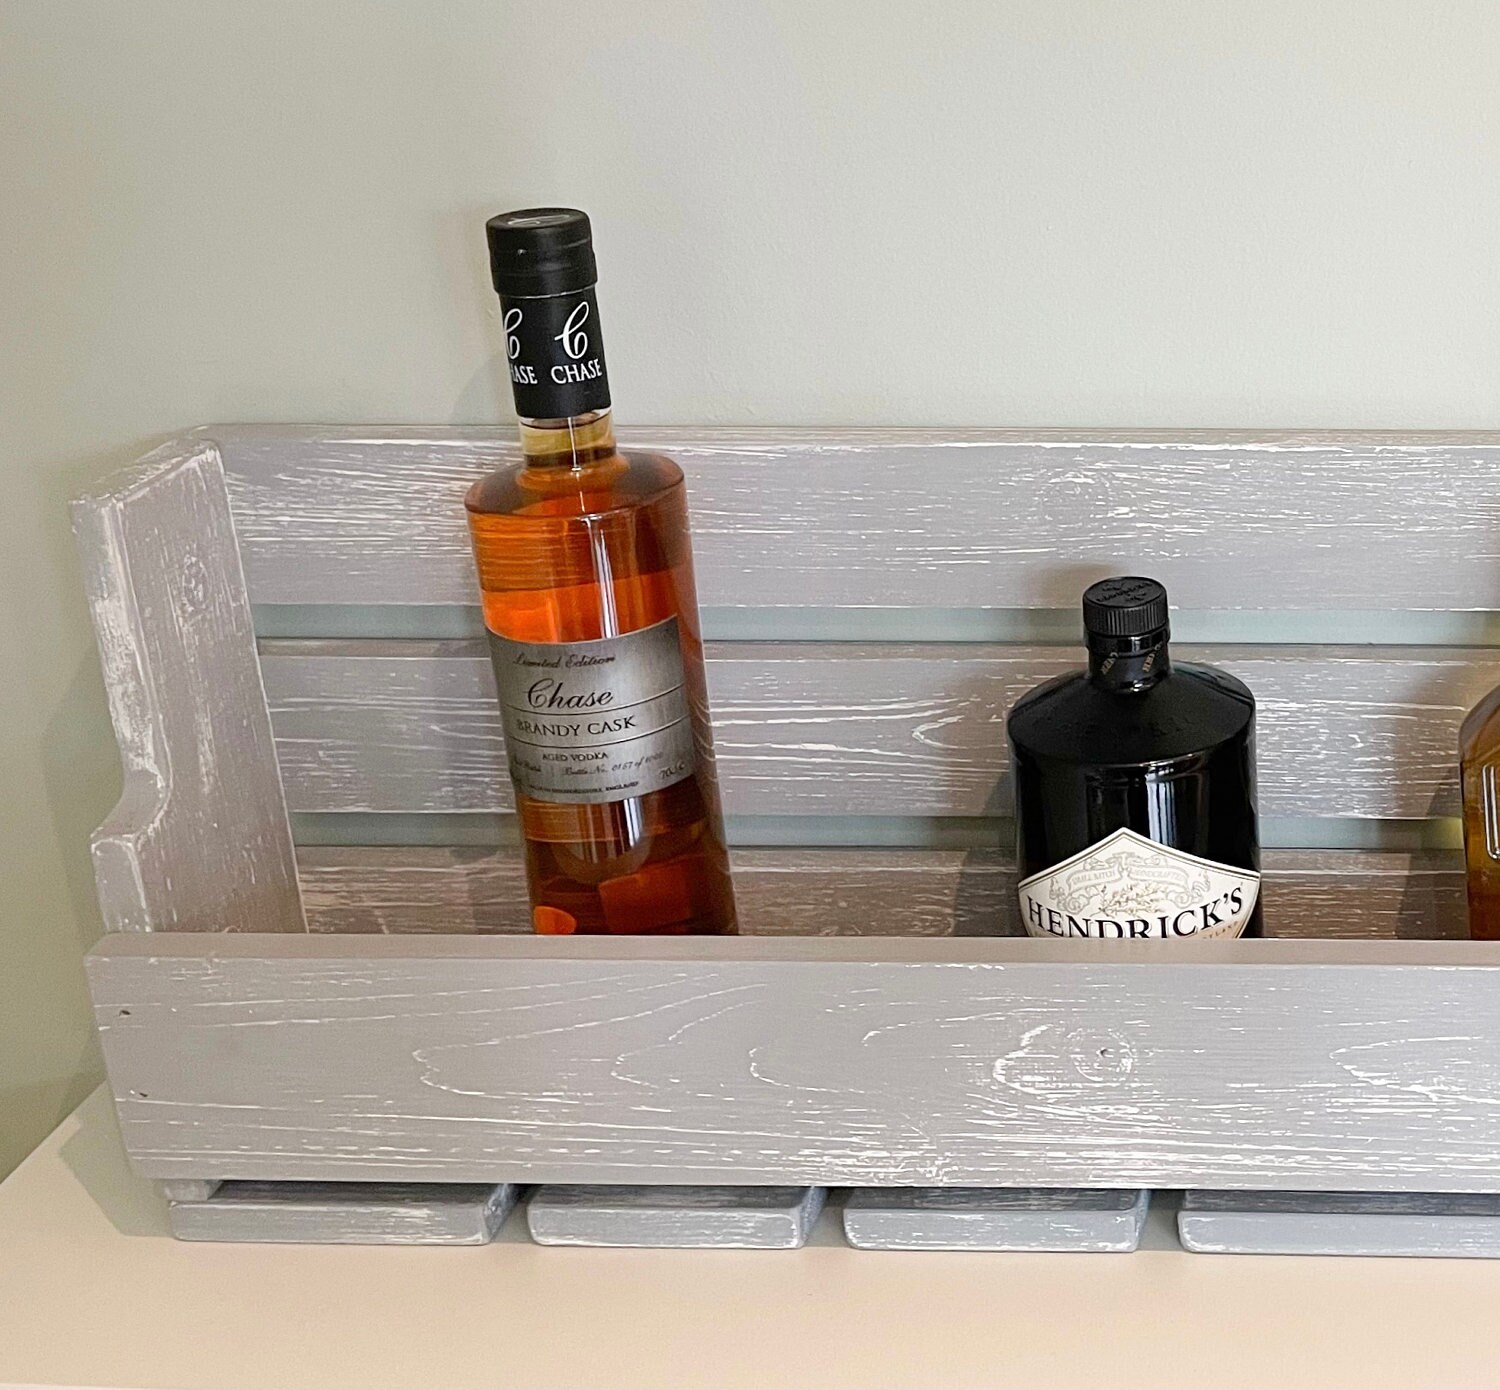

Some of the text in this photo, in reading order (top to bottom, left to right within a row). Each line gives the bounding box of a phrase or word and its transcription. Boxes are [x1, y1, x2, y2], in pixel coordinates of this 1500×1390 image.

[550, 358, 602, 385] CHASE
[513, 652, 616, 669] Limited Edition
[527, 678, 613, 709] Chase
[517, 715, 636, 737] BRANDY CASK
[542, 752, 608, 762] AGED VODKA
[1027, 886, 1243, 938] HENDRICK'S
